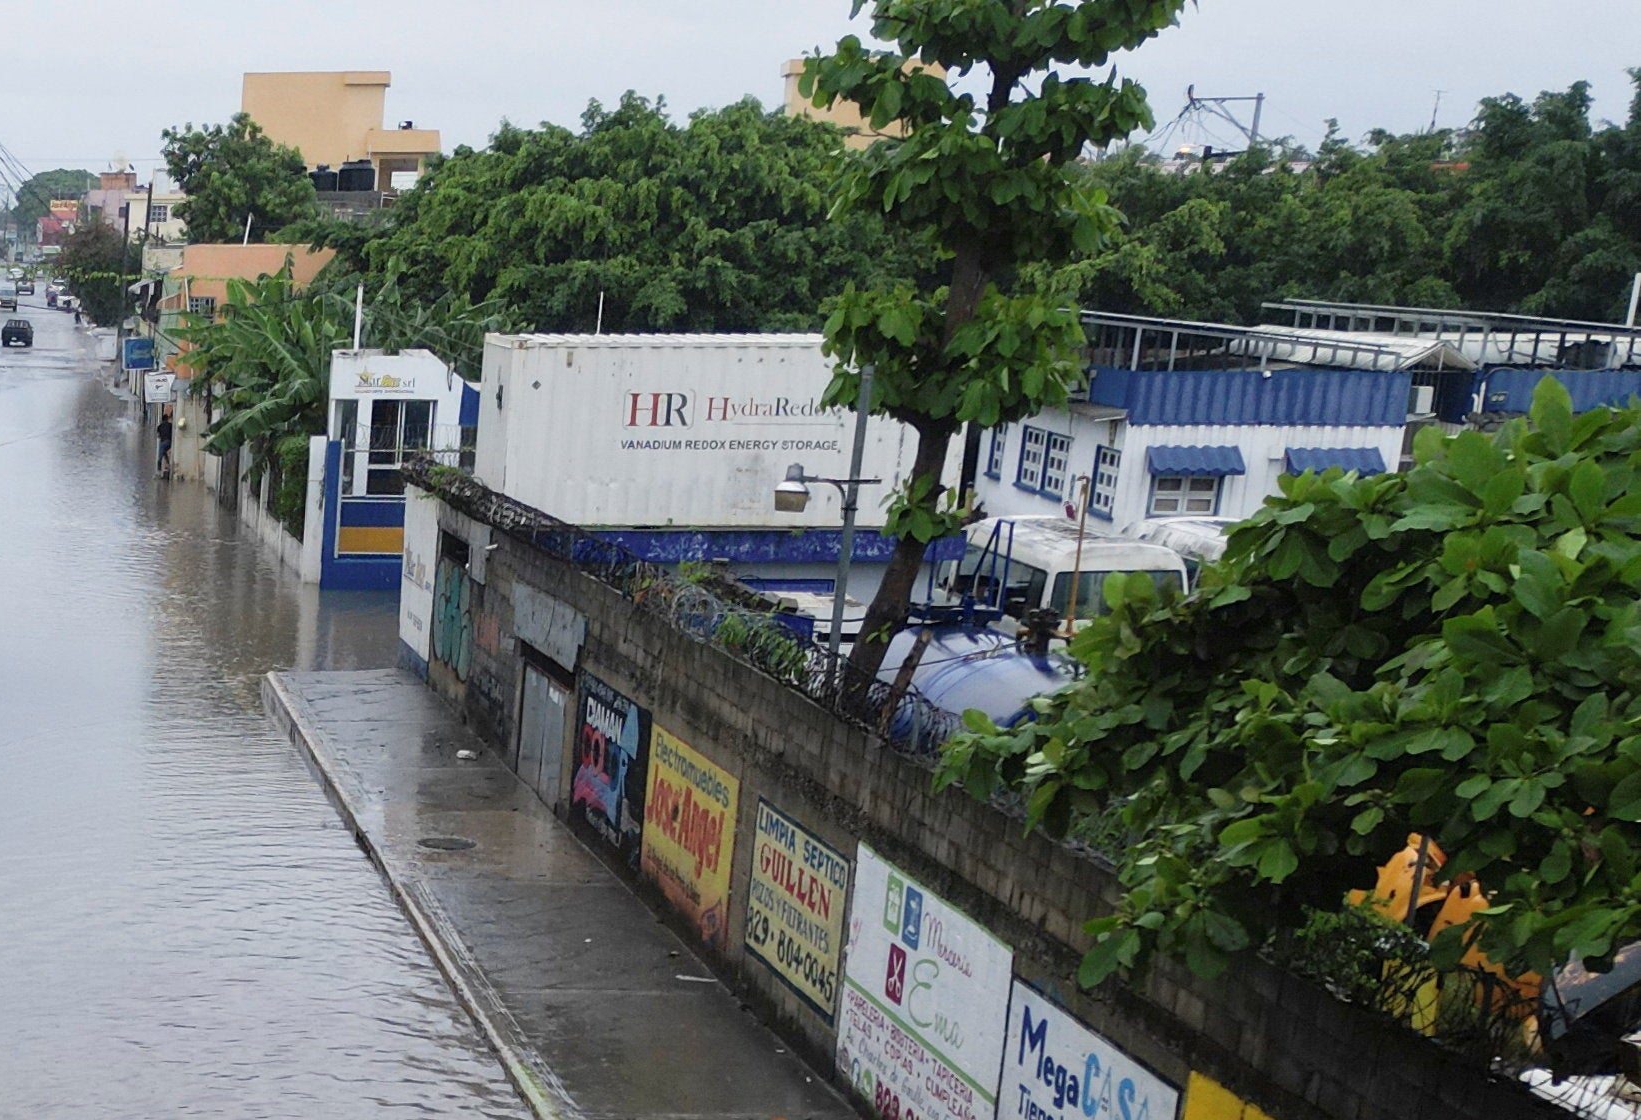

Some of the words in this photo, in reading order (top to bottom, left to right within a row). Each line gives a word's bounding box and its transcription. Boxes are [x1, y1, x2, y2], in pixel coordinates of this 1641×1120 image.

[625, 392, 689, 427] HR
[621, 440, 682, 450] VANADIUM
[685, 440, 726, 450] REDOX
[729, 440, 778, 450] ENERGY
[781, 440, 838, 450] STORAGE
[655, 733, 730, 809] Electromuebles
[758, 807, 796, 855] LIMPIA
[803, 840, 847, 891] SEPTICO
[760, 843, 832, 922] GUILLEN
[781, 900, 830, 955] FILTRANTES
[884, 1042, 914, 1076] COPIAS
[932, 1057, 974, 1106] TAPICERIA
